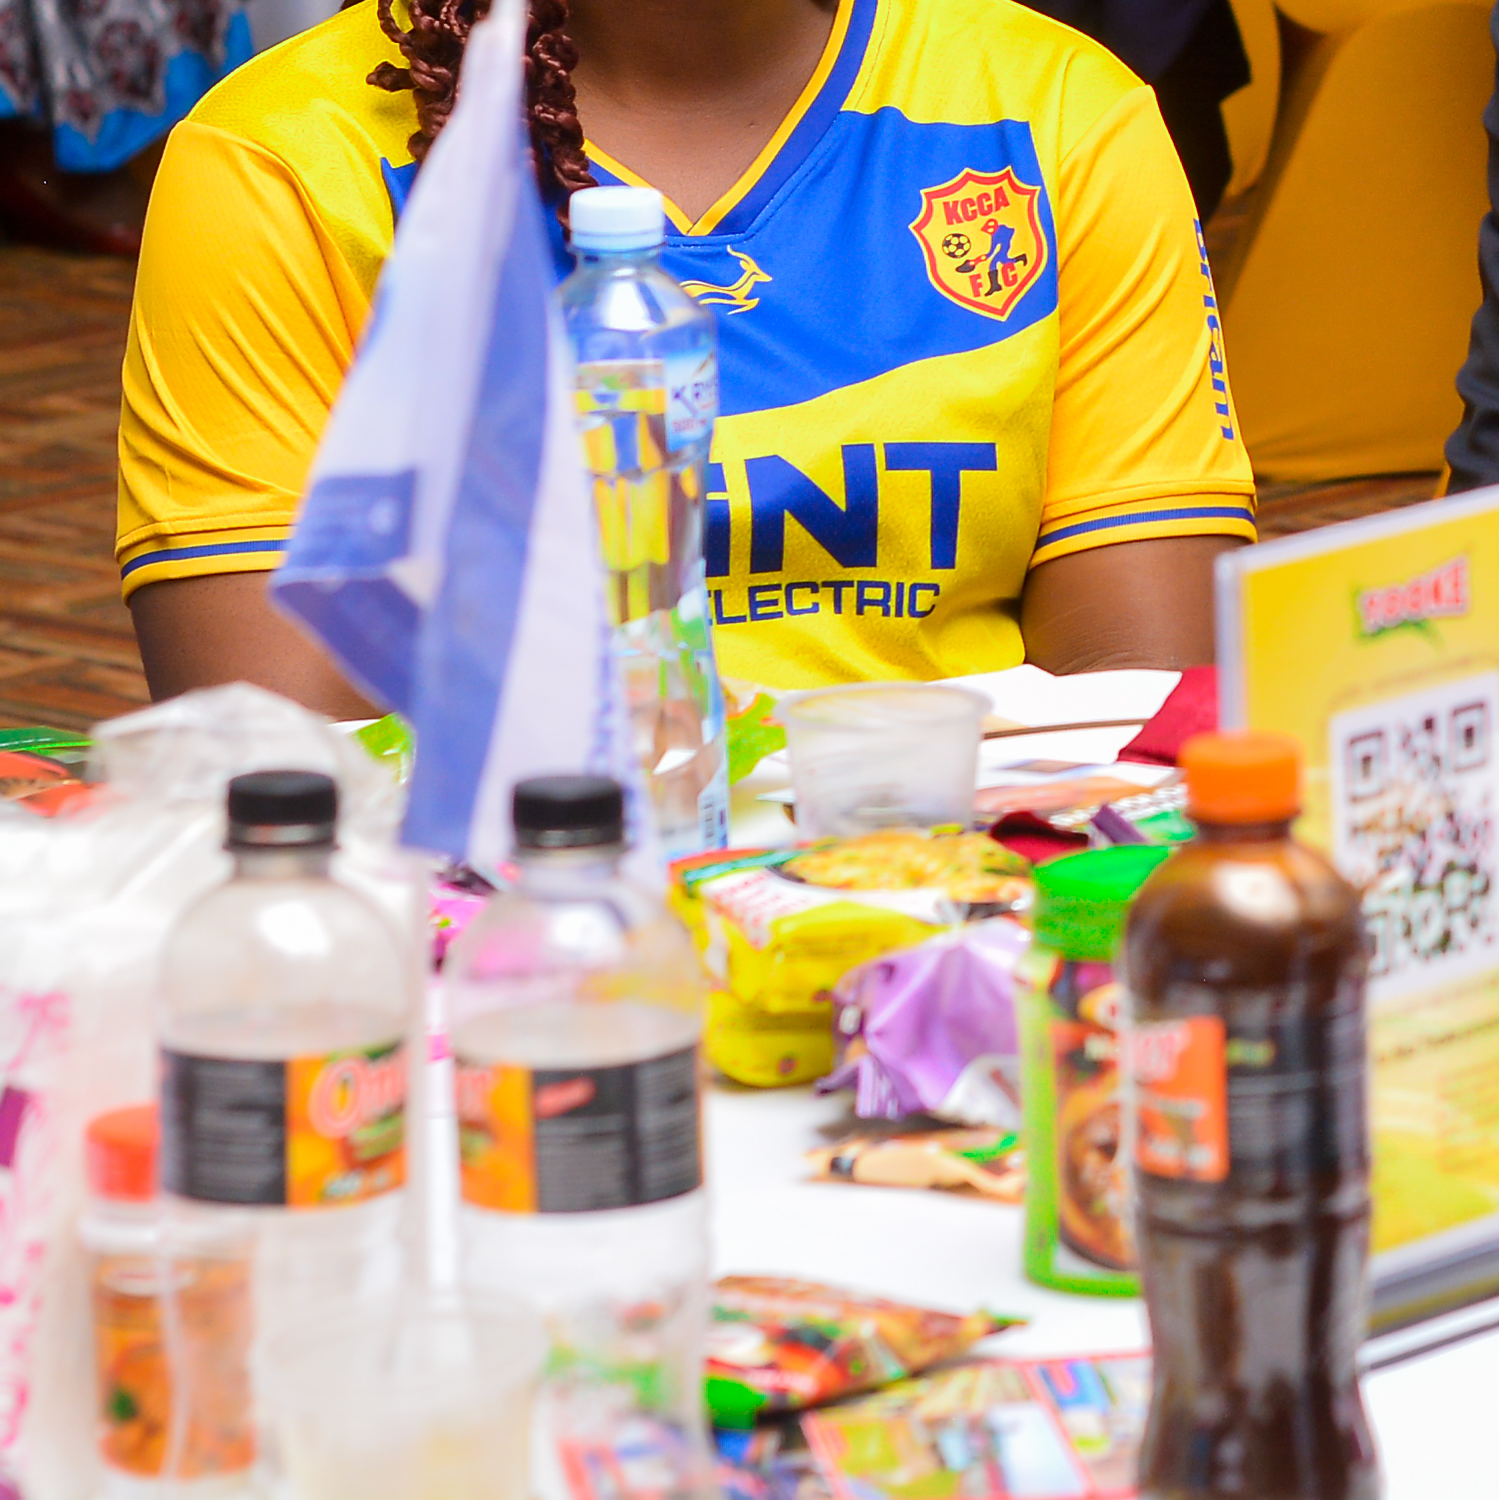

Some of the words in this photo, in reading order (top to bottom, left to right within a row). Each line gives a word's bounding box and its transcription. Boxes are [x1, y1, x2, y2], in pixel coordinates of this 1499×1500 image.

[942, 186, 1010, 226] KCCA
[968, 274, 984, 298] F
[1001, 262, 1019, 288] C
[709, 580, 940, 626] LECTRIC
